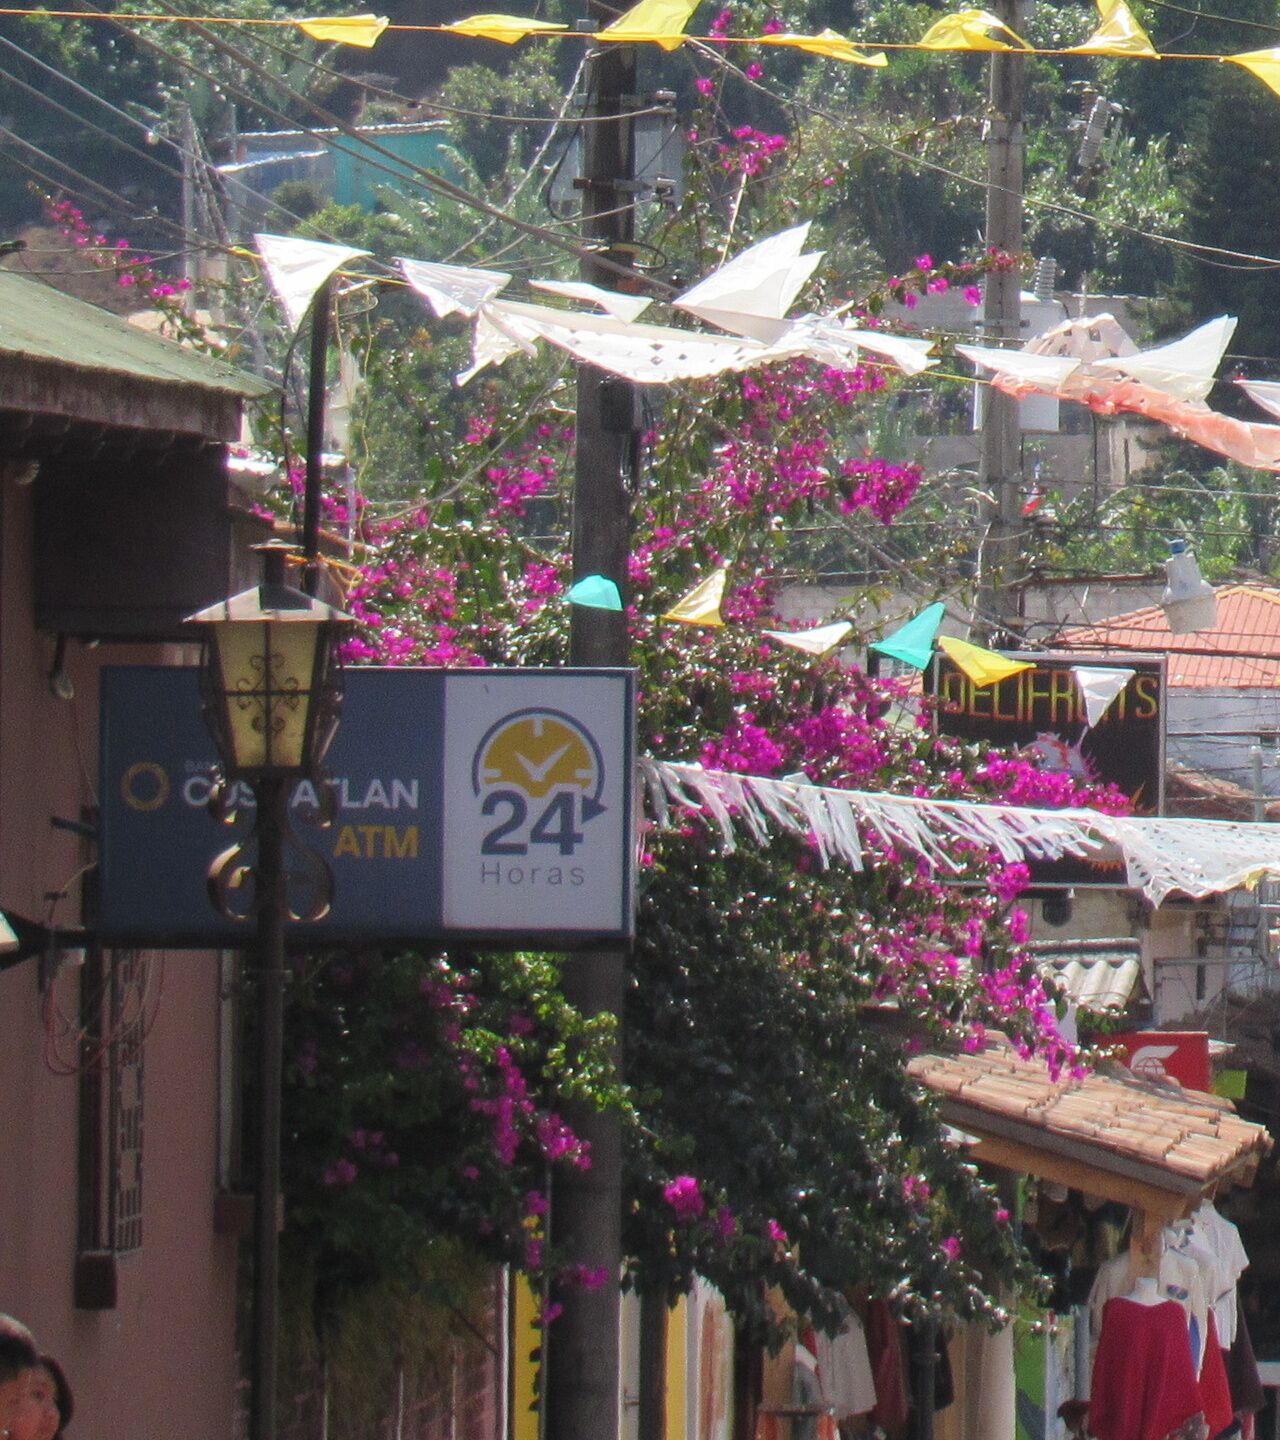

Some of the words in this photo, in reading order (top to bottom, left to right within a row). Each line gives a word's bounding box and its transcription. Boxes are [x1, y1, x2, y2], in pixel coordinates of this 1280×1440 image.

[943, 669, 1159, 723] DELIFRTS
[183, 775, 419, 809] CSALAN
[481, 789, 584, 855] 24
[332, 824, 419, 859] ATM
[480, 861, 585, 886] Horas
